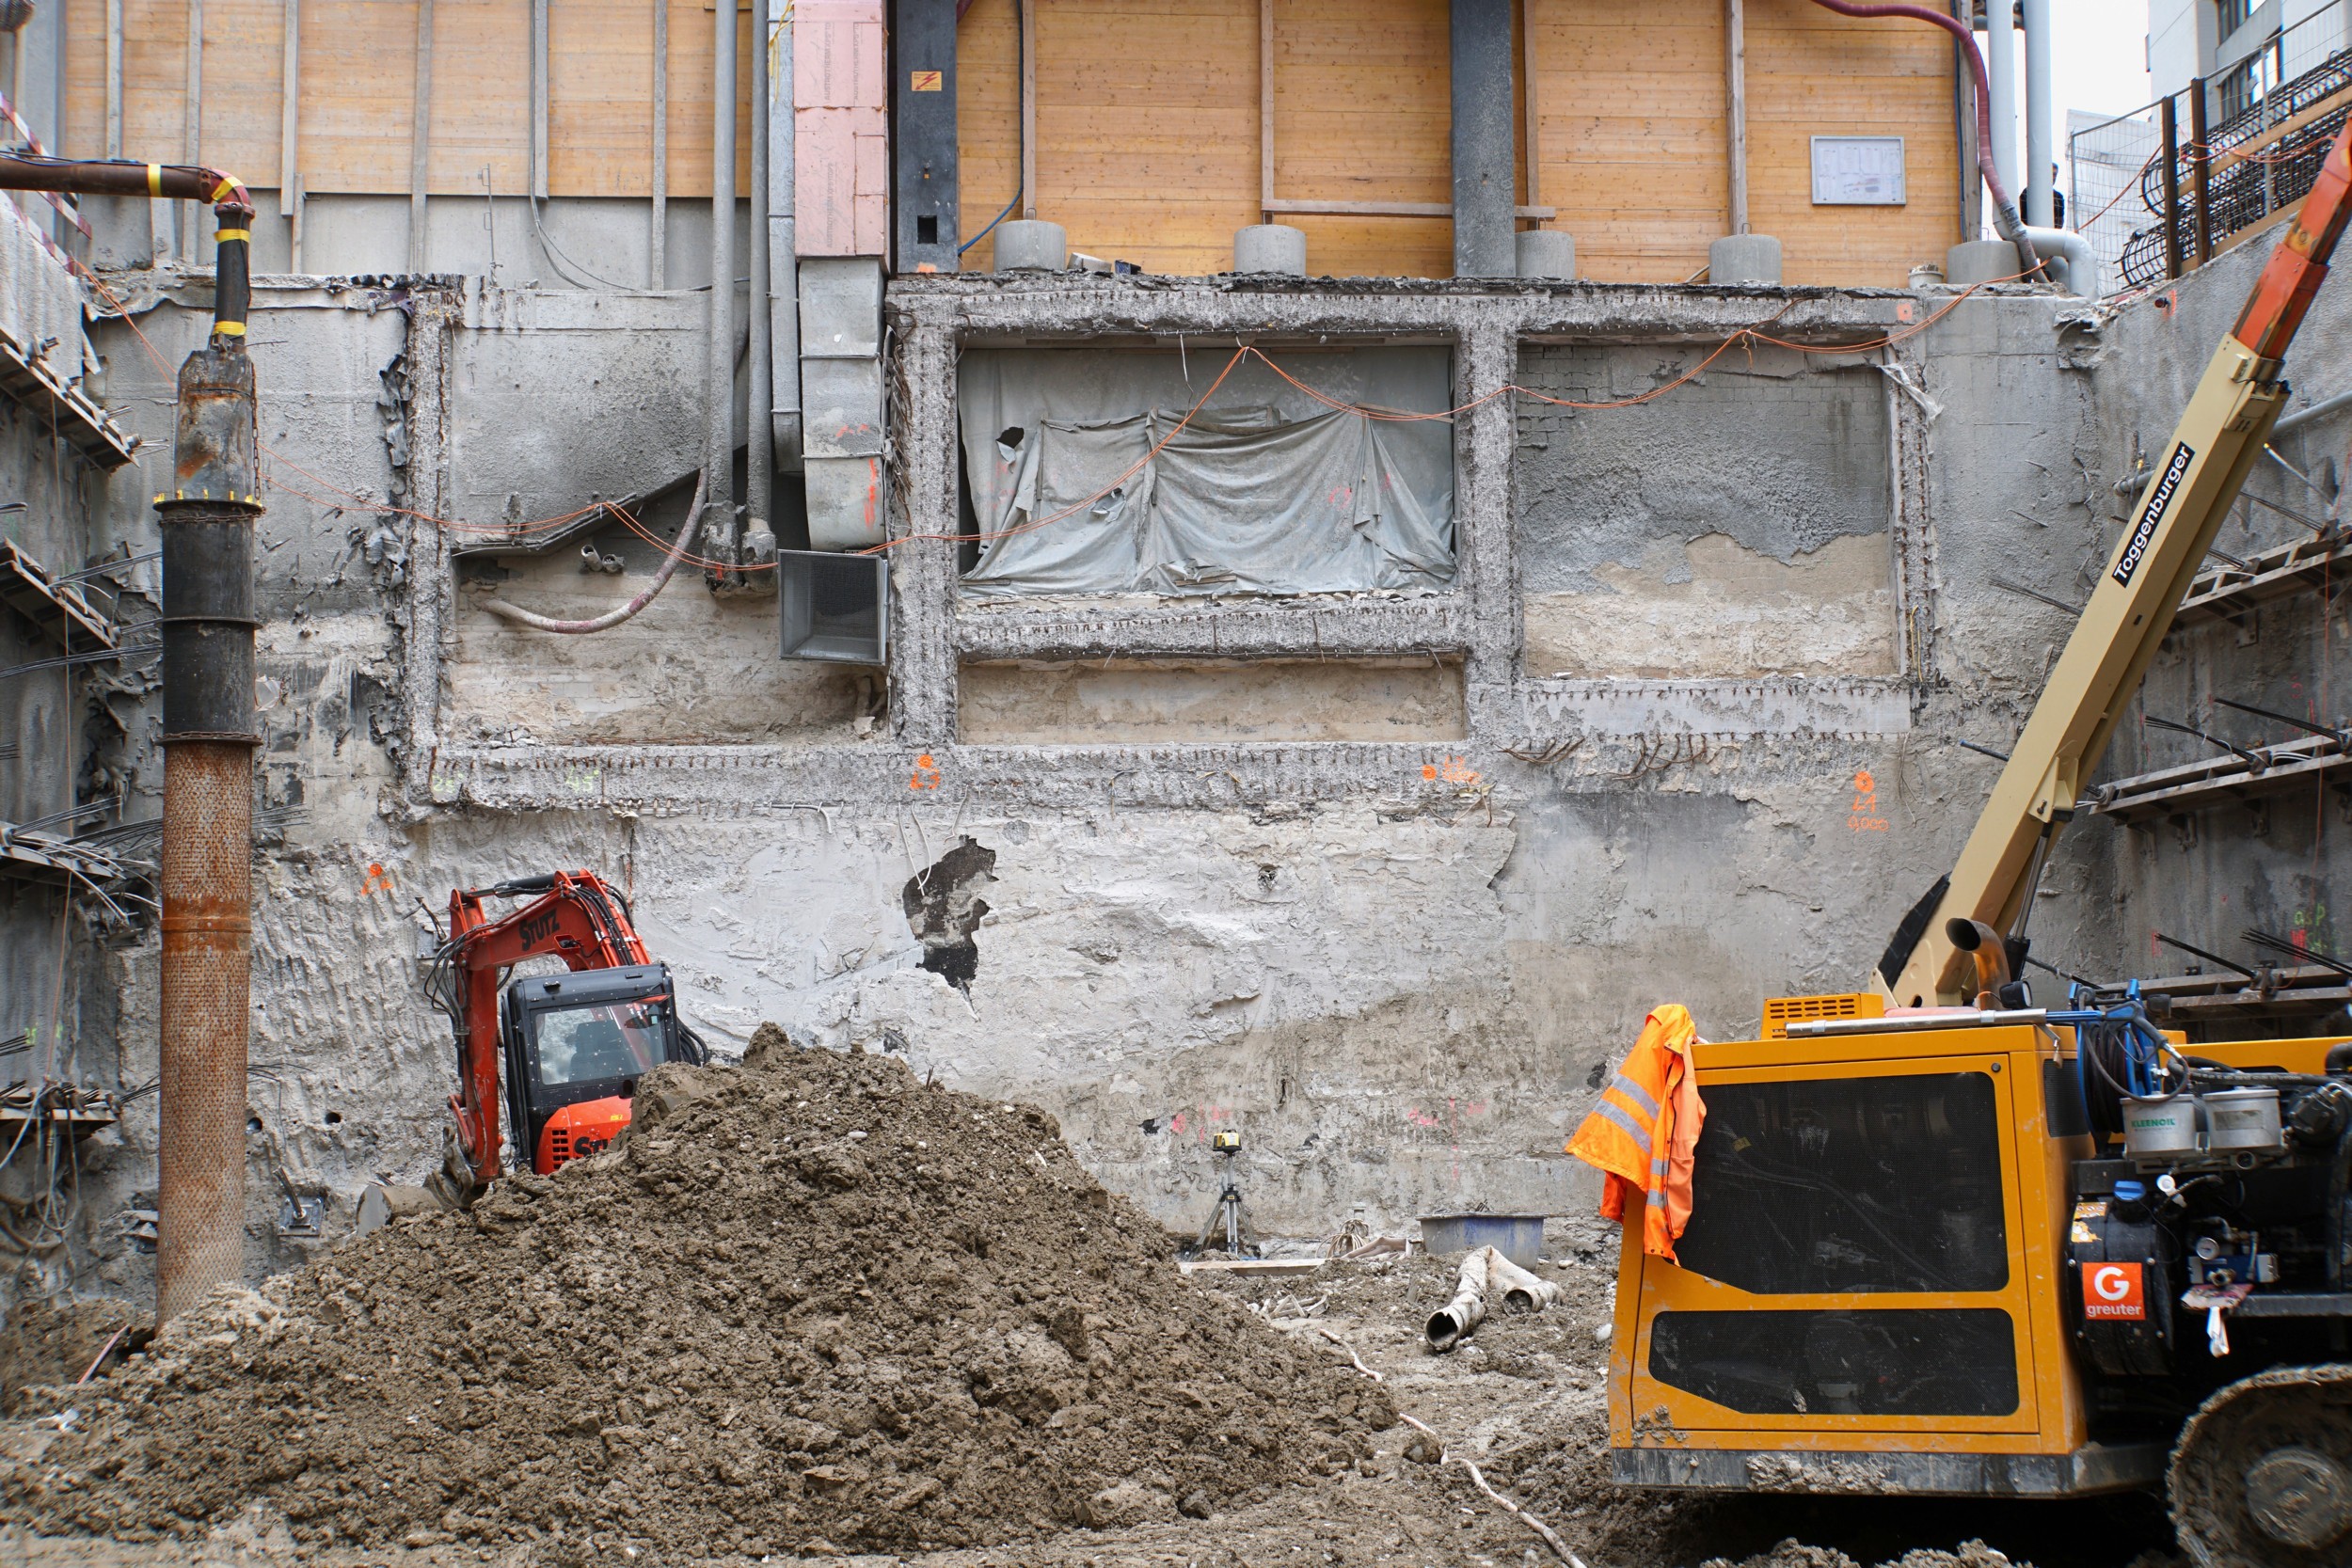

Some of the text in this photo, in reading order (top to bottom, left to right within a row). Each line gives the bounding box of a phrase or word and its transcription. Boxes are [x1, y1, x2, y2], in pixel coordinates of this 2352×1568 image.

[2113, 446, 2190, 578] Toggenburger
[2131, 1117, 2176, 1128] KLEENOIL
[2094, 1266, 2130, 1301] G
[2086, 1304, 2142, 1318] greuter
